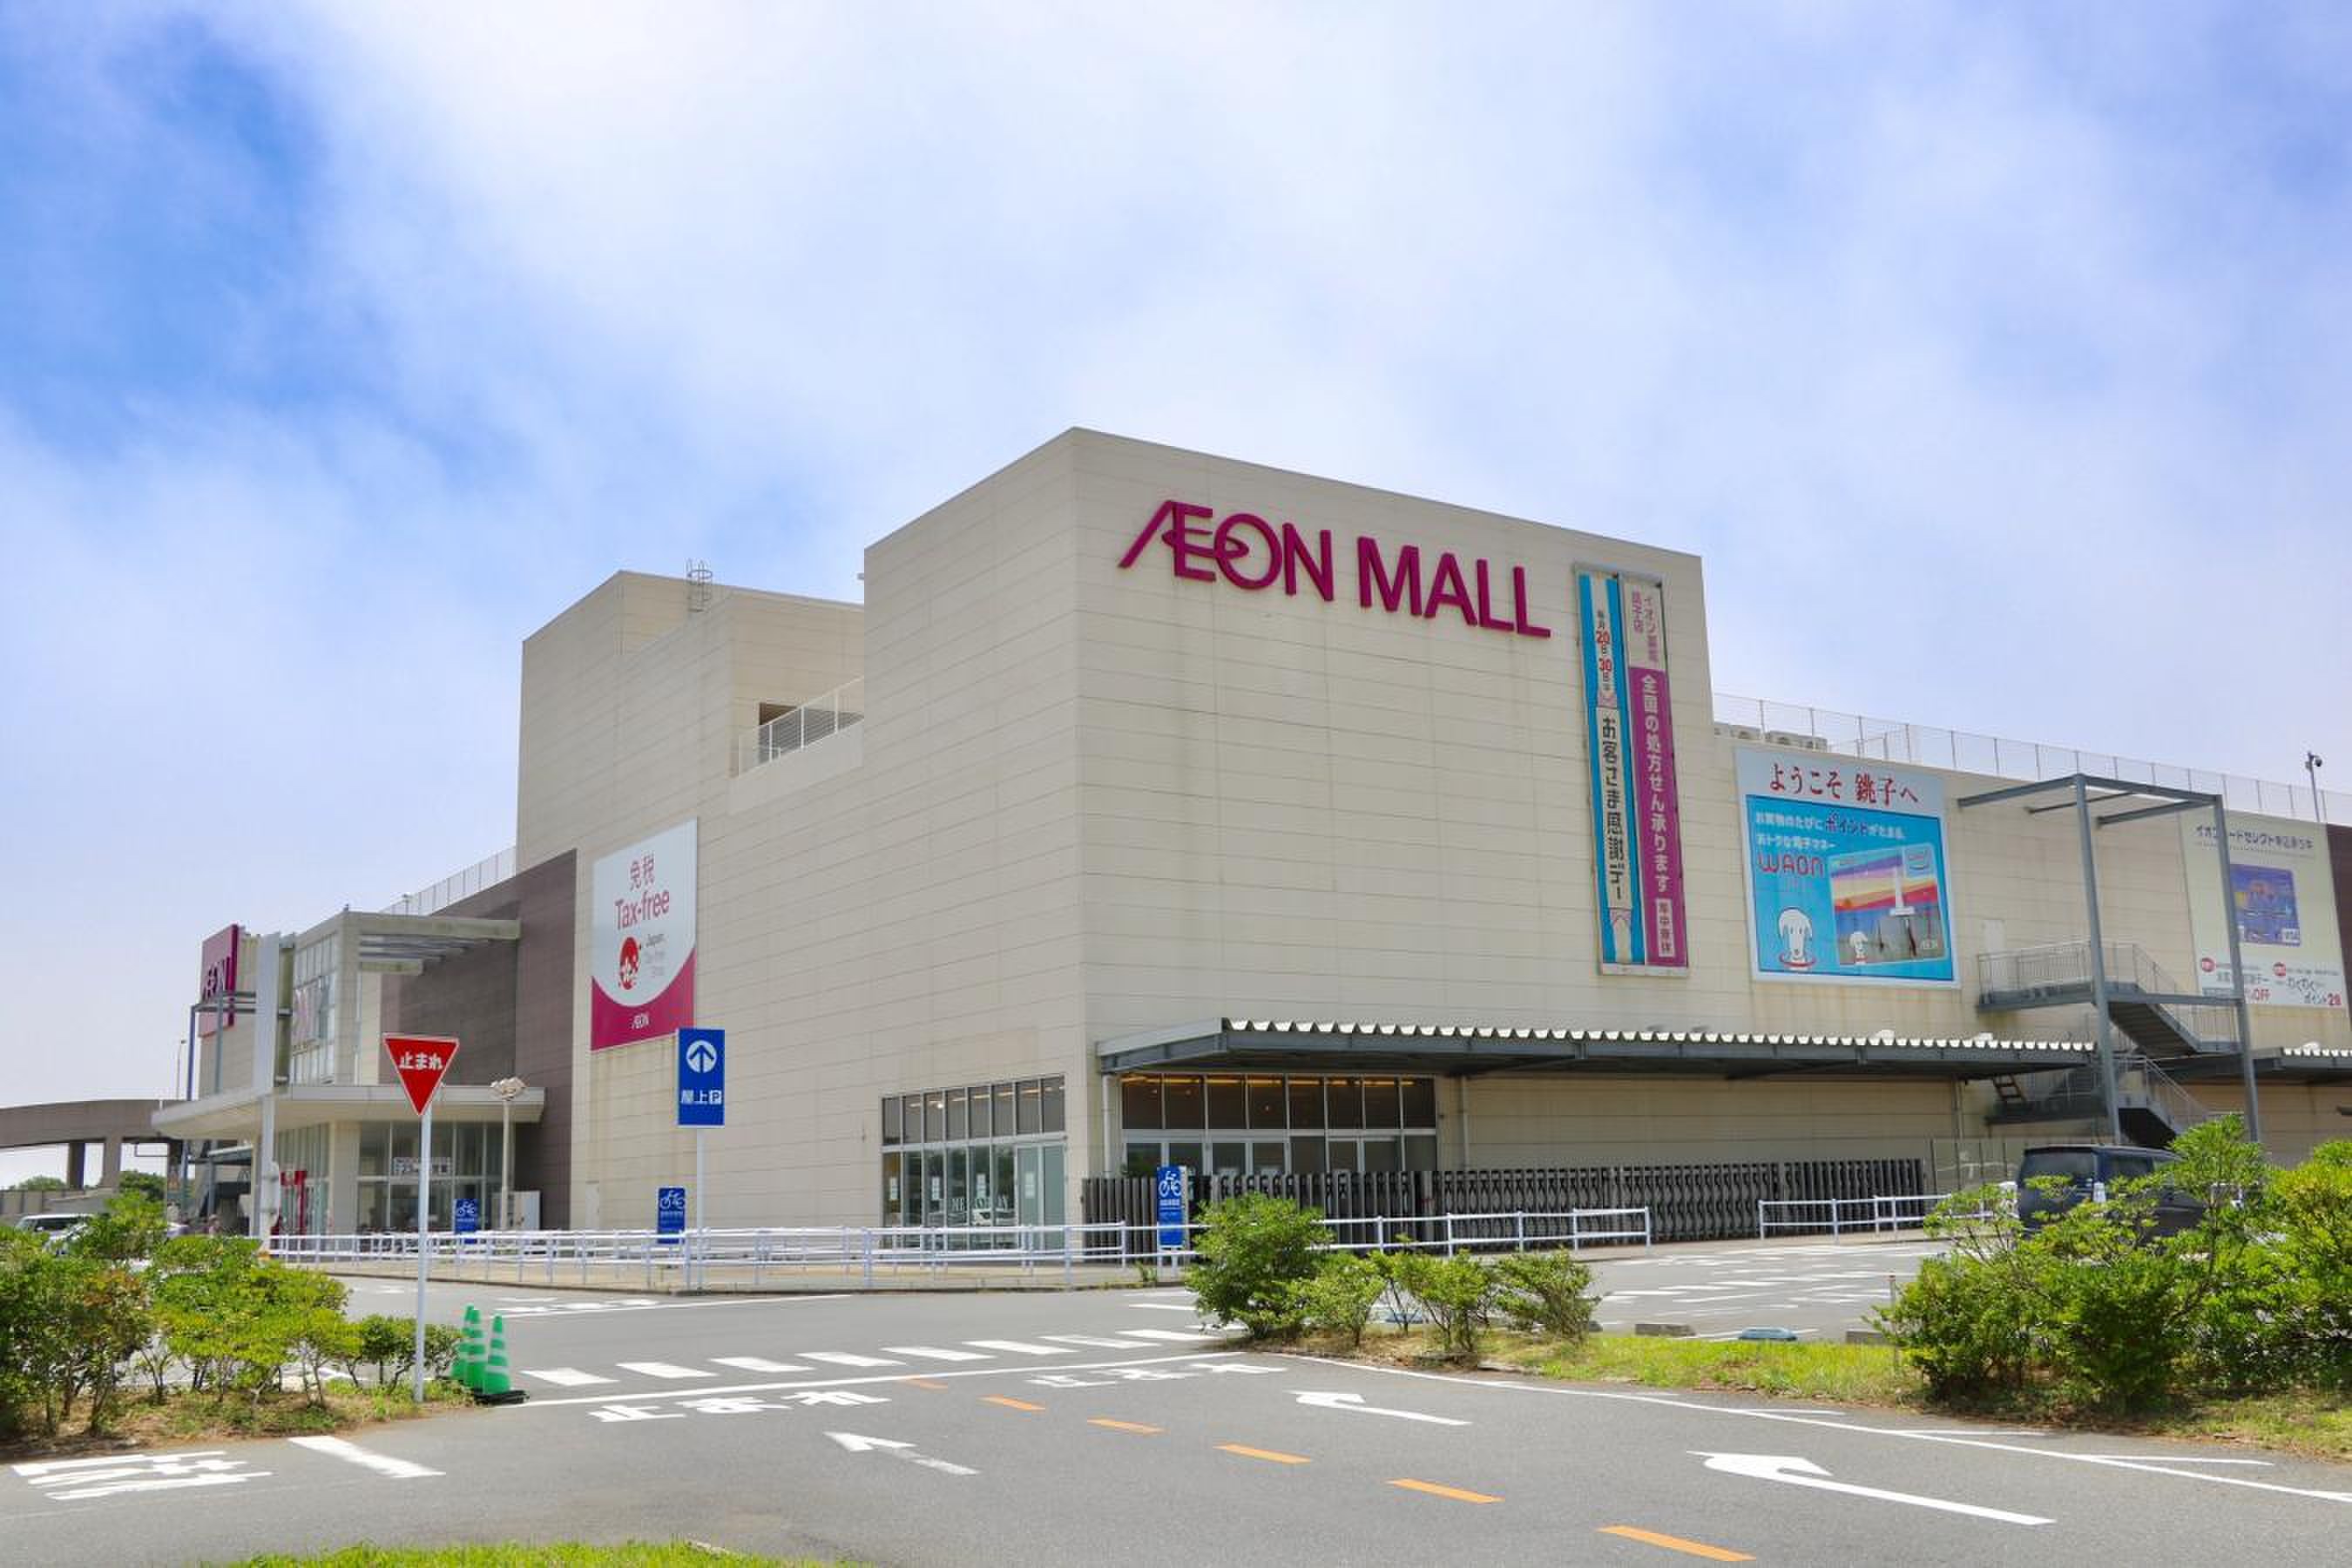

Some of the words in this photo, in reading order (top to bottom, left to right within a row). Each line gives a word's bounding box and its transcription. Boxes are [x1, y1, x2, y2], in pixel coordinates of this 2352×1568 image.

[1357, 537, 1551, 638] MALL
[1769, 763, 1842, 799] ようこそ
[1855, 774, 1919, 806] 銚子へ
[615, 889, 670, 930] Tax-free
[399, 1051, 443, 1071] 止まれ
[587, 1390, 893, 1423] 止まれ
